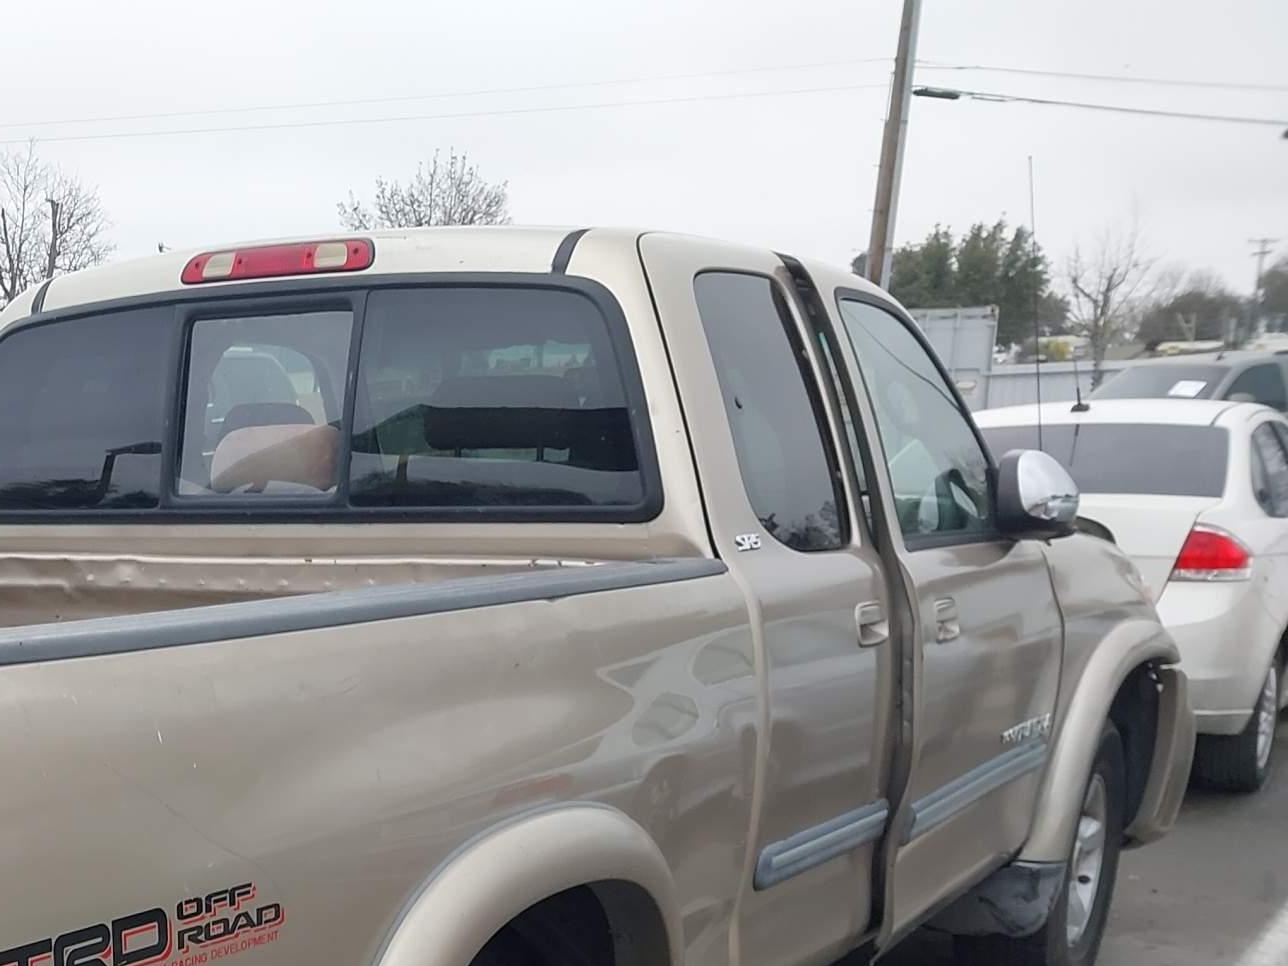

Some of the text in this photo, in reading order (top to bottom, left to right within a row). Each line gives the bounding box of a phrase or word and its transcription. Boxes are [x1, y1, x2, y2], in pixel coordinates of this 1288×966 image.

[176, 882, 257, 924] OFF
[177, 903, 285, 954] ROAD
[211, 931, 280, 961] DEVELOPMENT
